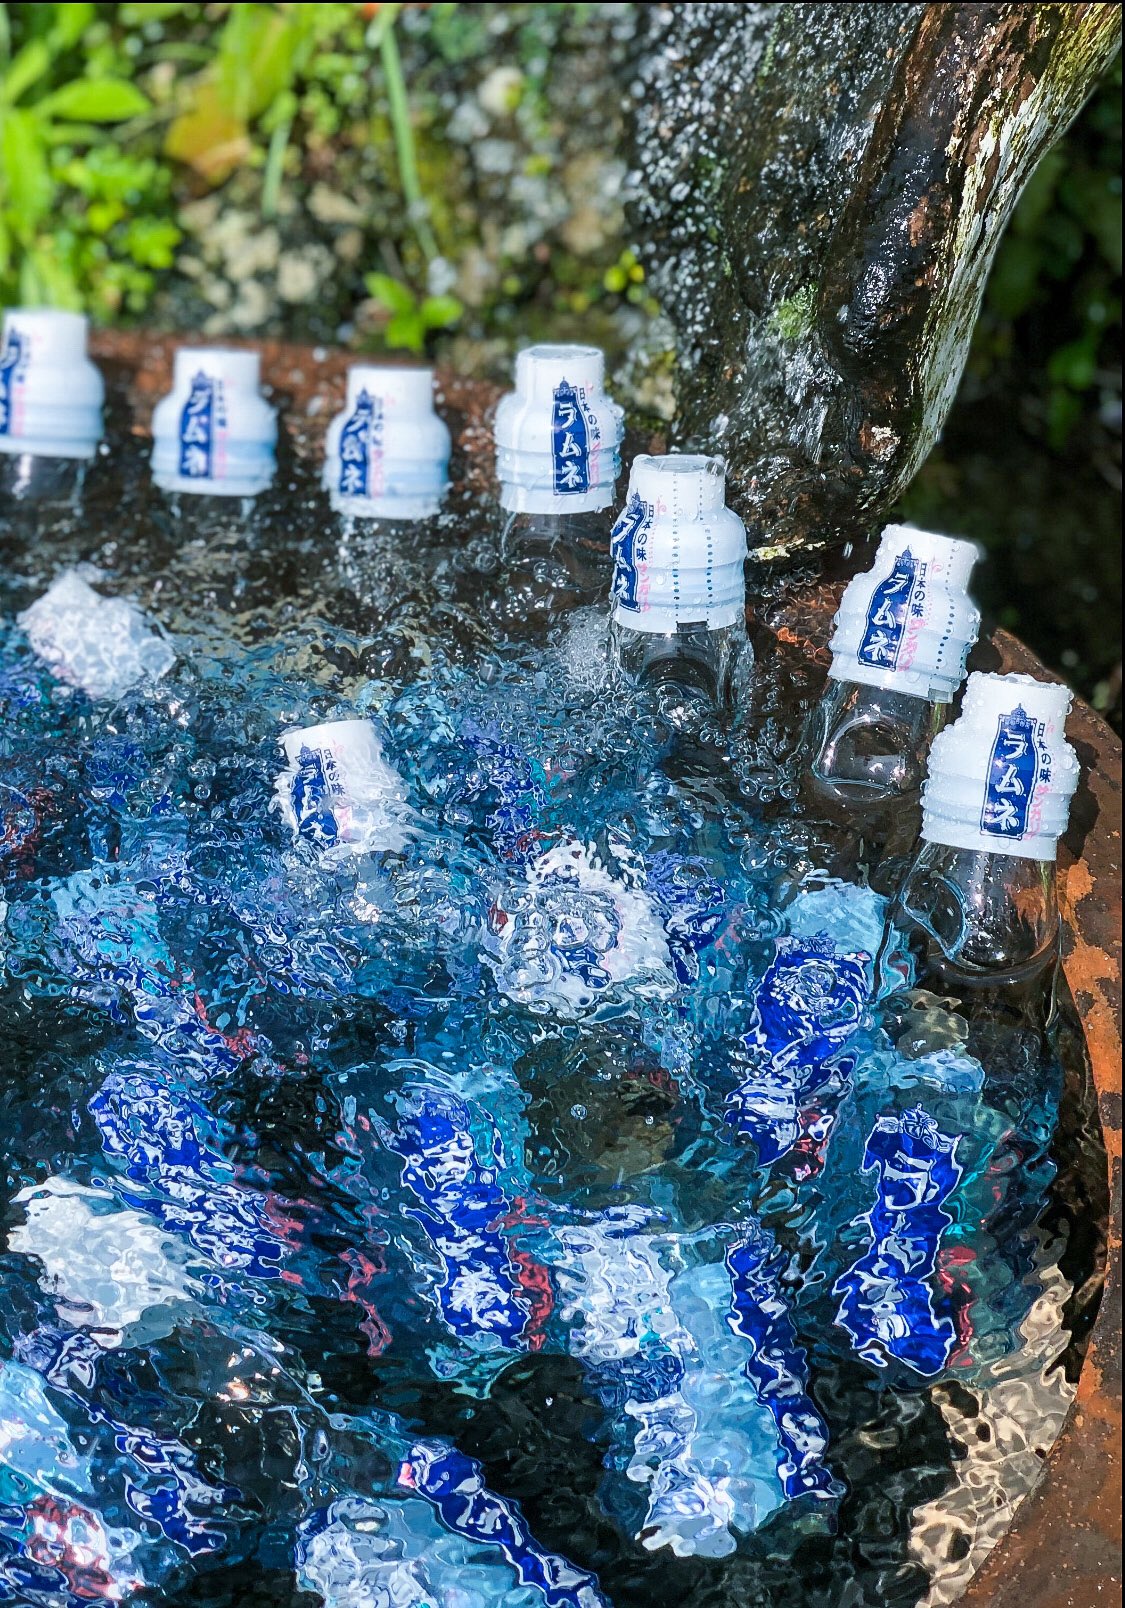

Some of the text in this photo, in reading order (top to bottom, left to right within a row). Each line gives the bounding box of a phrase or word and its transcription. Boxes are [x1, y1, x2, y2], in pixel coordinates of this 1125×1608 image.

[579, 387, 602, 441] 日本の味
[557, 402, 584, 489] ラムネ
[611, 513, 640, 601] ラムネ
[636, 504, 655, 562] 日本の味
[864, 572, 910, 662] ラムネ
[911, 562, 928, 618] 日本の味
[323, 748, 346, 797] 日本の味
[988, 731, 1029, 832] ラムネ
[1036, 722, 1052, 784] 日本の味
